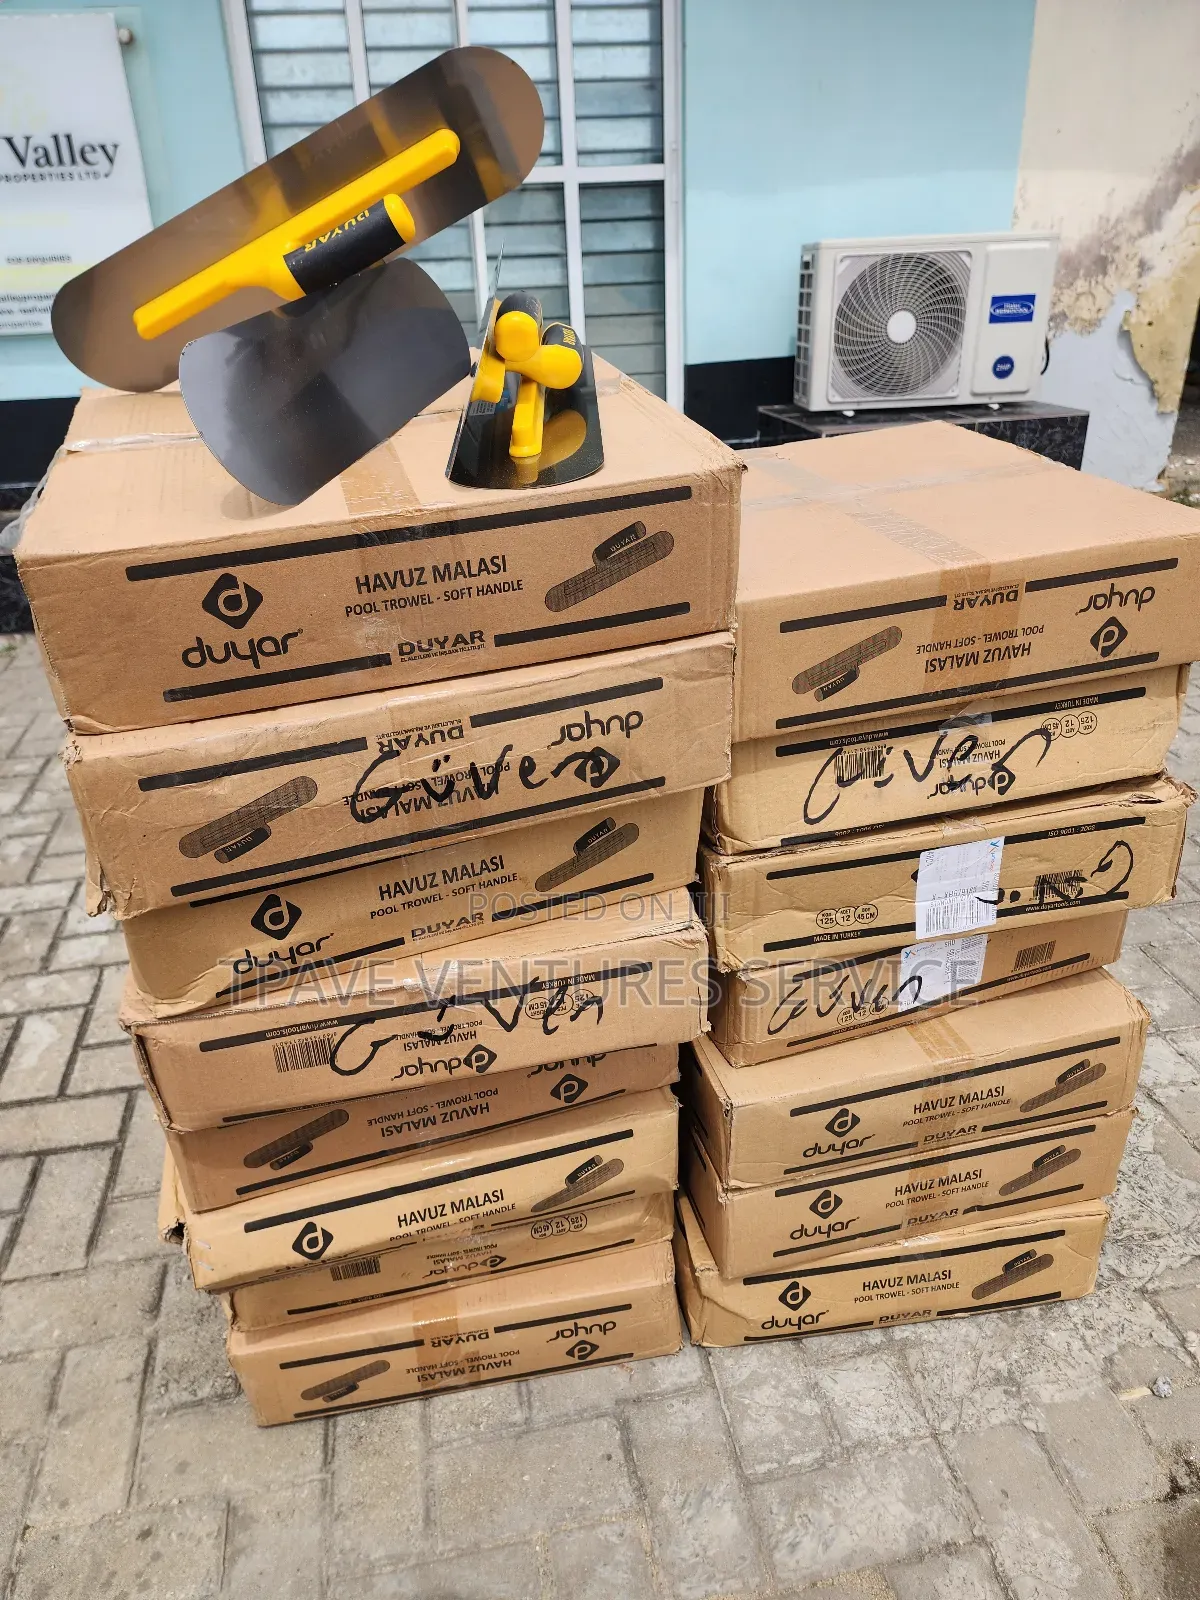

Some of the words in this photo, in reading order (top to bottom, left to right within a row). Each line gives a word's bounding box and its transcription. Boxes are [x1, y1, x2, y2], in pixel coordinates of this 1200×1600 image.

[0, 132, 119, 178] Valley
[355, 567, 427, 594] HAVUZ
[431, 555, 507, 583] MALASI
[345, 602, 380, 617] POOL
[382, 594, 434, 611] TROWEL
[443, 587, 472, 601] SOFT
[476, 579, 524, 596] HANDLE
[953, 589, 1019, 611] DUYAR
[1079, 583, 1155, 613] duyar
[983, 628, 1019, 643] TROWEL
[1021, 624, 1045, 636] POOL
[182, 632, 300, 669] duyar
[397, 630, 486, 656] DUYAR
[916, 640, 952, 655] HANDLE
[953, 636, 976, 648] SOFT
[925, 651, 980, 673] MALASI
[983, 642, 1032, 663] HAVUZ
[551, 710, 643, 746] duyar
[1065, 719, 1075, 728] 12
[1080, 716, 1094, 725] 125
[377, 725, 464, 754] DUYAR
[971, 749, 1001, 763] HAVUZ
[431, 769, 478, 788] ROWEL
[378, 872, 439, 901] HAVUZ
[441, 855, 505, 885] MALASI
[370, 906, 399, 920] POOL
[400, 893, 444, 911] TROWEL
[451, 884, 477, 898] SOFT
[478, 872, 519, 890] HANDLE
[411, 912, 485, 939] DUYAR
[820, 917, 834, 925] 125
[841, 914, 851, 923] 12
[233, 934, 331, 975] duyar
[576, 974, 596, 984] MADE
[265, 1019, 340, 1038] www.duyartools.com
[465, 1019, 483, 1028] POOL
[443, 1030, 477, 1045] HAVUZ
[393, 1057, 464, 1081] duyar
[436, 1093, 473, 1109] TROWEL
[473, 1088, 499, 1099] POOL
[913, 1096, 956, 1115] HAVUZ
[959, 1085, 1005, 1106] MALASI
[367, 1112, 405, 1127] HANDLE
[407, 1105, 429, 1117] SOFT
[441, 1102, 490, 1123] HAVUZ
[902, 1118, 923, 1127] POOL
[924, 1110, 956, 1123] TROWEL
[961, 1105, 980, 1114] SOFT
[980, 1098, 1012, 1110] HANDLE
[381, 1116, 437, 1138] MALASI
[924, 1124, 978, 1142] DUYAR
[802, 1136, 873, 1158] duyar
[895, 1179, 935, 1197] HAVUZ
[937, 1169, 982, 1188] MALASI
[885, 1200, 905, 1209] POOL
[906, 1193, 937, 1205] TROWEL
[941, 1187, 959, 1197] SOFT
[960, 1181, 990, 1193] HANDLE
[397, 1203, 448, 1229] HAVUZ
[450, 1188, 505, 1215] MALASI
[482, 1203, 517, 1218] HANDLE
[907, 1208, 959, 1226] DUYAR
[789, 1218, 857, 1240] duyar
[424, 1261, 479, 1278] duyar
[862, 1276, 904, 1292] HAVUZ
[906, 1269, 952, 1285] MALASI
[854, 1295, 874, 1304] POOL
[876, 1290, 905, 1301] TROWEL
[911, 1286, 929, 1296] SOFT
[930, 1281, 960, 1292] HANDLE
[761, 1310, 826, 1331] duyar
[879, 1309, 932, 1323] DUYAR
[431, 1332, 490, 1349] DUYAR
[550, 1320, 617, 1343] duyar
[465, 1353, 498, 1364] TROWEL
[499, 1350, 520, 1358] POOL
[405, 1363, 438, 1375] HANDLE
[439, 1360, 459, 1368] SOFT
[468, 1359, 512, 1373] HAVUZ
[417, 1367, 466, 1383] MALASI
